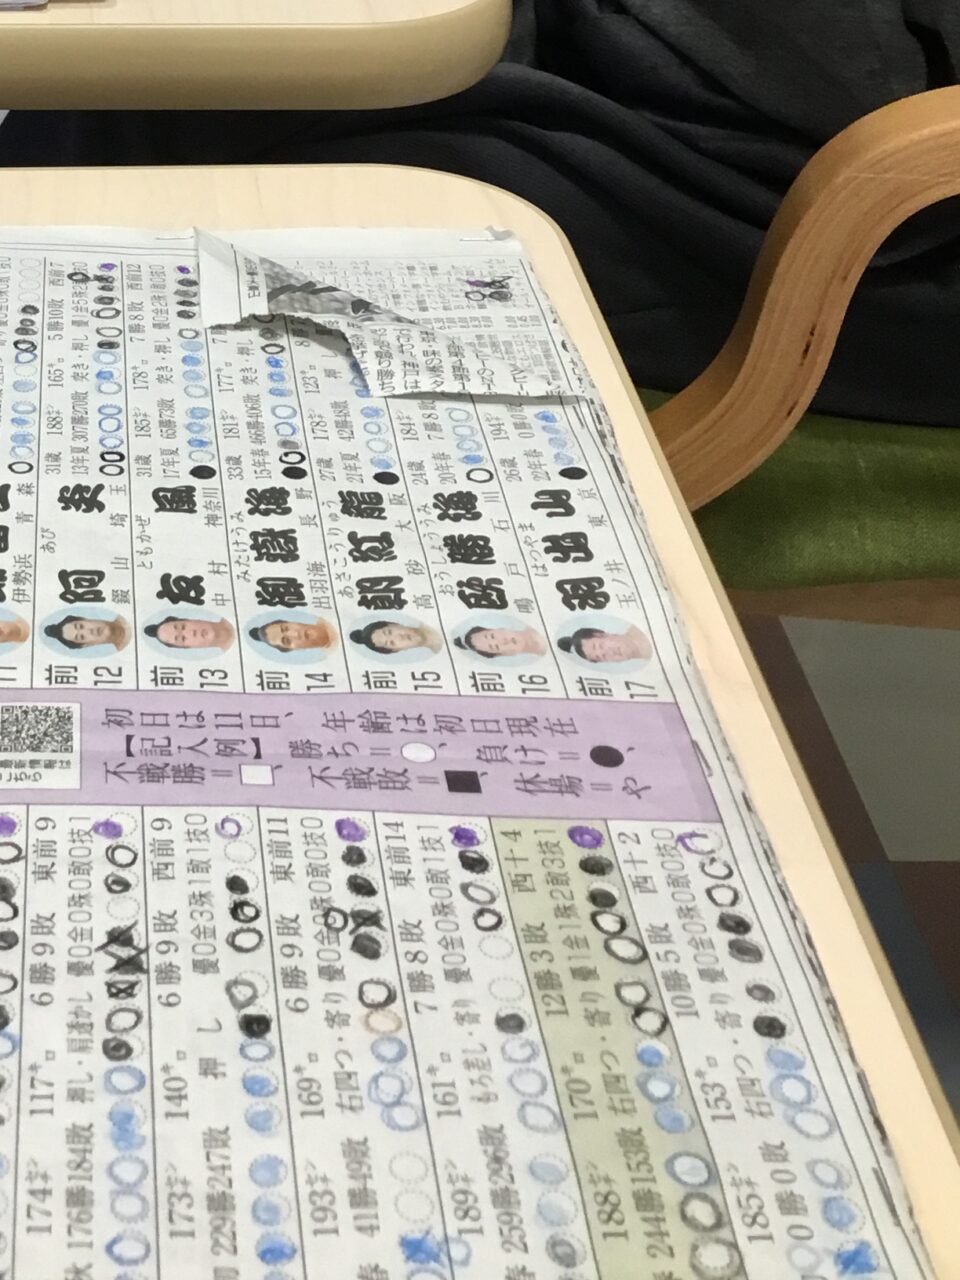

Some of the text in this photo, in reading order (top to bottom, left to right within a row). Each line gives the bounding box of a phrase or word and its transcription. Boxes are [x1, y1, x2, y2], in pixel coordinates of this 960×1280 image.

[58, 483, 107, 604] 阿炎
[151, 485, 206, 605] 友風
[244, 486, 308, 607] 御嶽海
[337, 490, 409, 610] 朝紅龍
[531, 489, 610, 610] 羽出山
[48, 664, 124, 686] 前12
[151, 665, 228, 688] 前13
[257, 671, 335, 691] 前14
[362, 671, 441, 691] 前15
[471, 672, 550, 694] 前16
[577, 676, 659, 699] 前17
